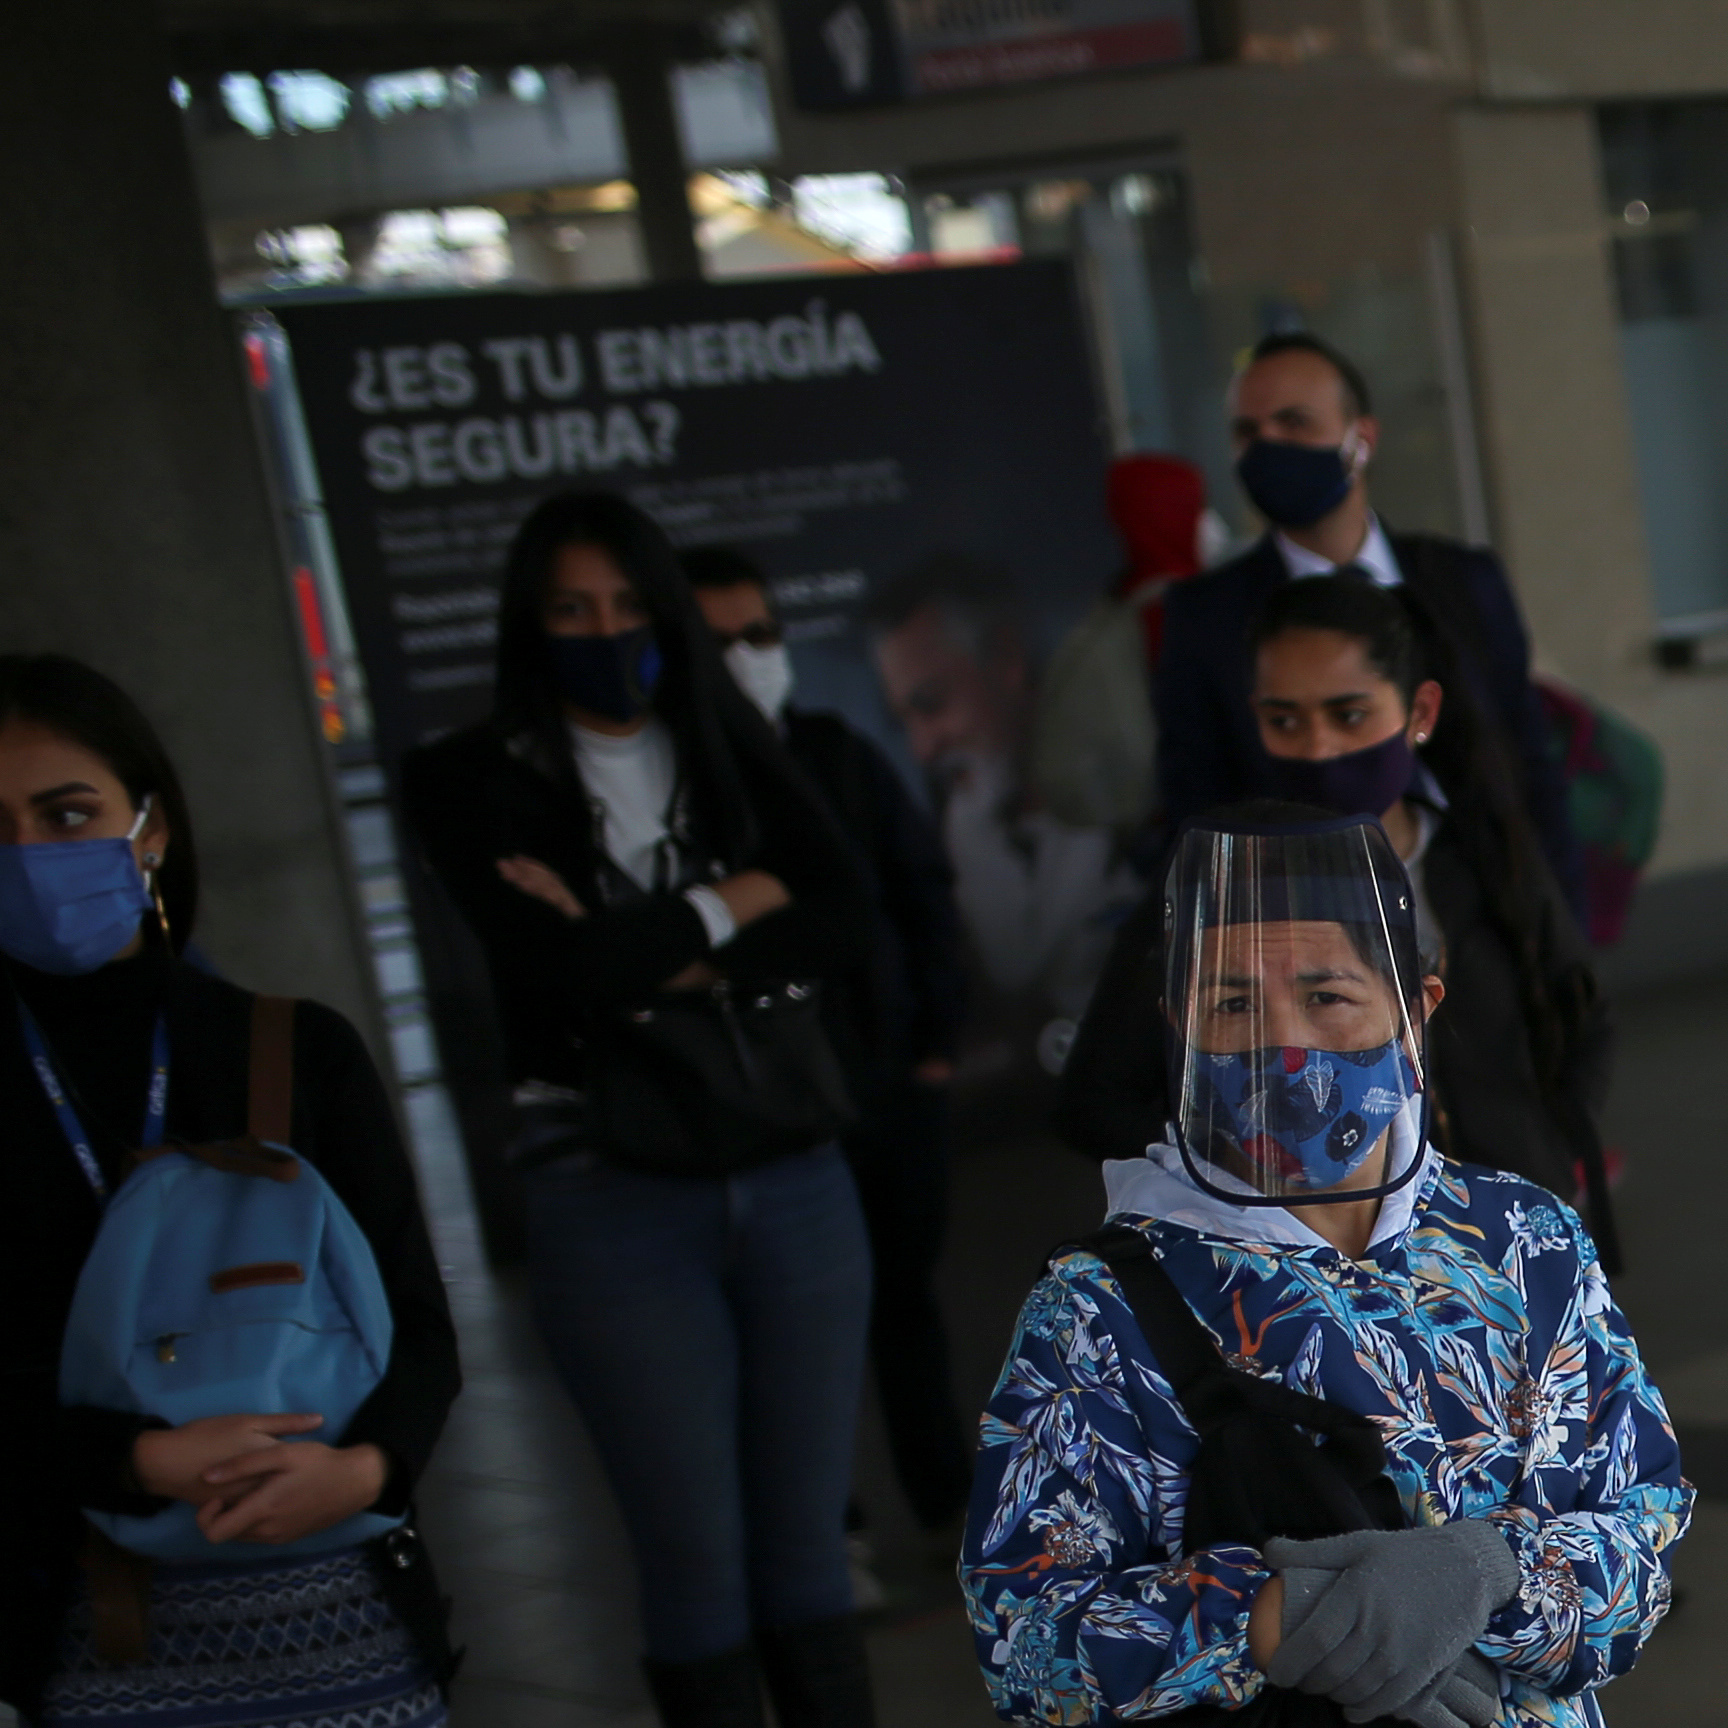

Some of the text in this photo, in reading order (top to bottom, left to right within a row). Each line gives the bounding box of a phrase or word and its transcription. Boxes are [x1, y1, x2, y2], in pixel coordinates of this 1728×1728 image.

[350, 300, 881, 413] ¿ES TU ENERGÍA
[361, 401, 683, 492] SEGURA?
